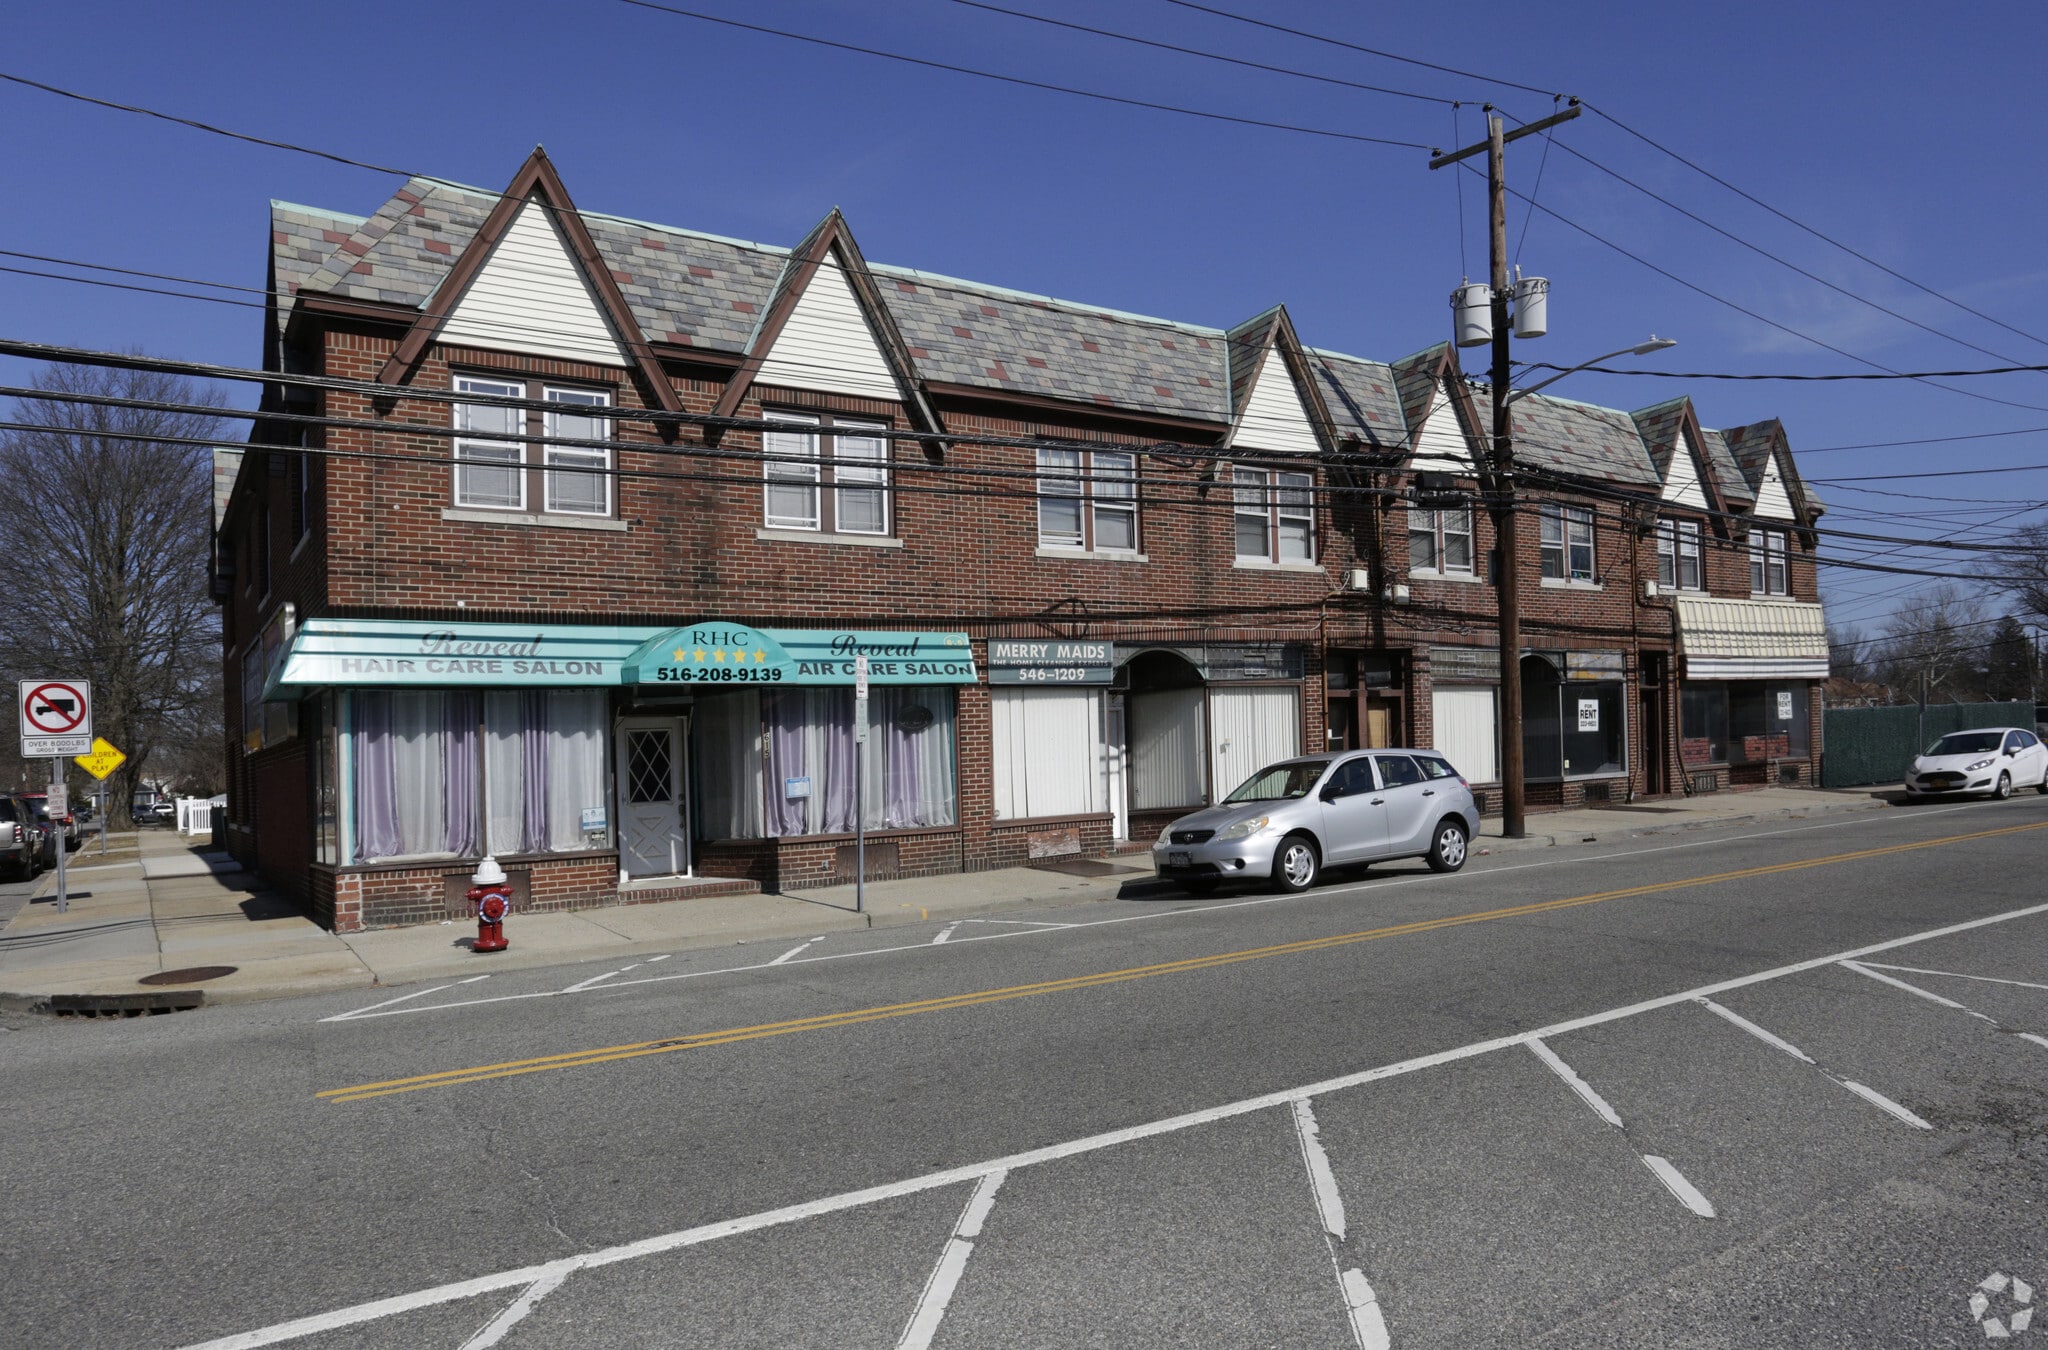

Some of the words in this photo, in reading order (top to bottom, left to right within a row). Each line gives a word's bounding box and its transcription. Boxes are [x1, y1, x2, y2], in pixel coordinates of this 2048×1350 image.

[419, 629, 544, 658] Reveal
[692, 630, 748, 646] RHC
[831, 634, 919, 657] Reveal
[996, 644, 1048, 658] MERRY
[1057, 645, 1105, 659] MAIDS
[341, 658, 416, 673] HAIR
[426, 659, 503, 673] CARE
[512, 660, 602, 676] SALON
[905, 663, 972, 675] SALON
[1037, 659, 1074, 667] CLEANING
[657, 667, 782, 682] 516-208-9139
[1019, 668, 1085, 681] 546-1209
[1580, 709, 1597, 719] RENT
